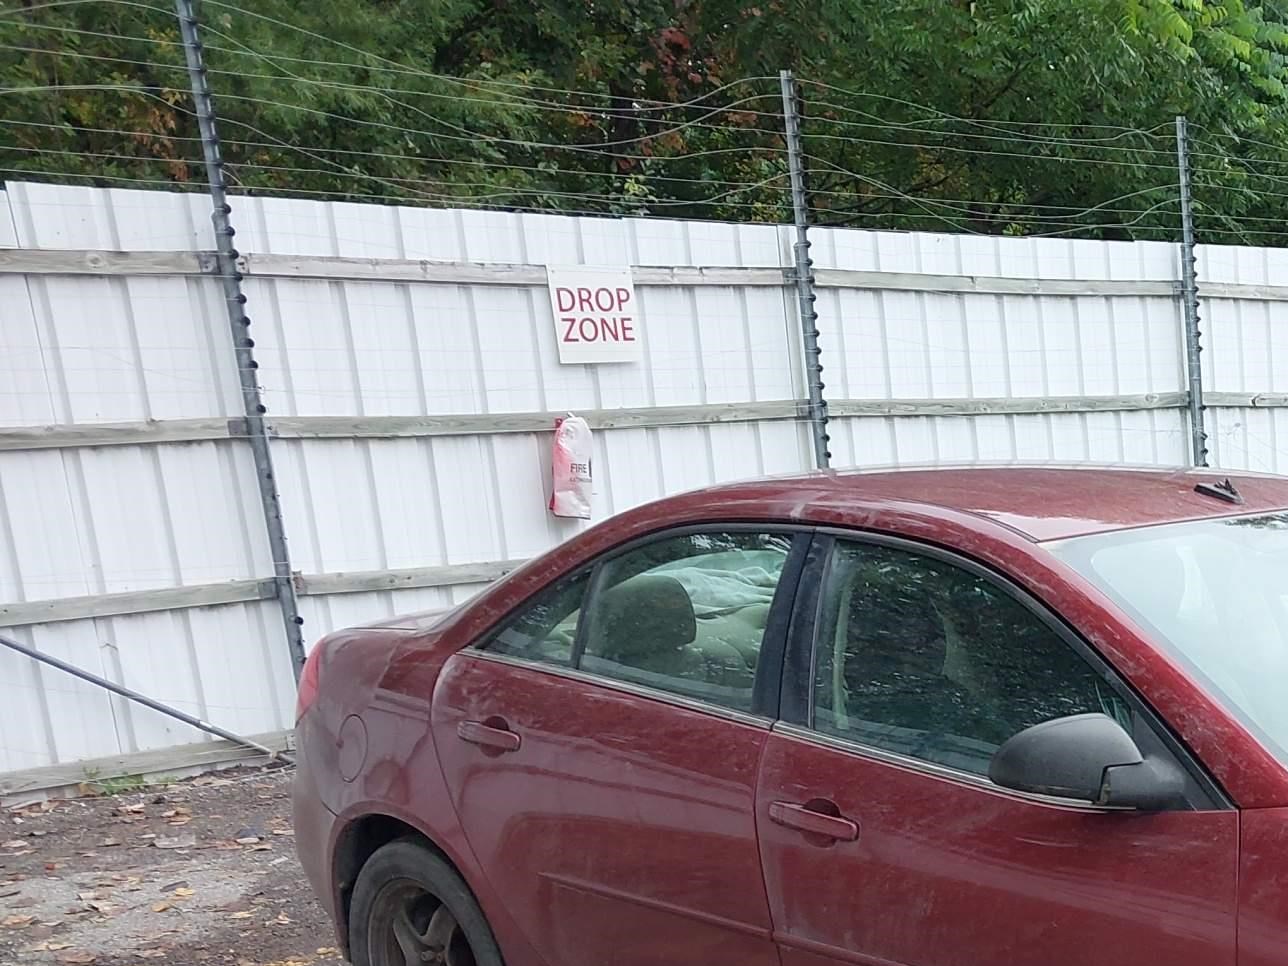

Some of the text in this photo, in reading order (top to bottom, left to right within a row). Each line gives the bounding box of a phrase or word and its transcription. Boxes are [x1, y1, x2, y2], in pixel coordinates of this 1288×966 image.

[556, 288, 630, 312] DROP
[561, 317, 635, 342] ZONE
[570, 463, 587, 473] FIRE
